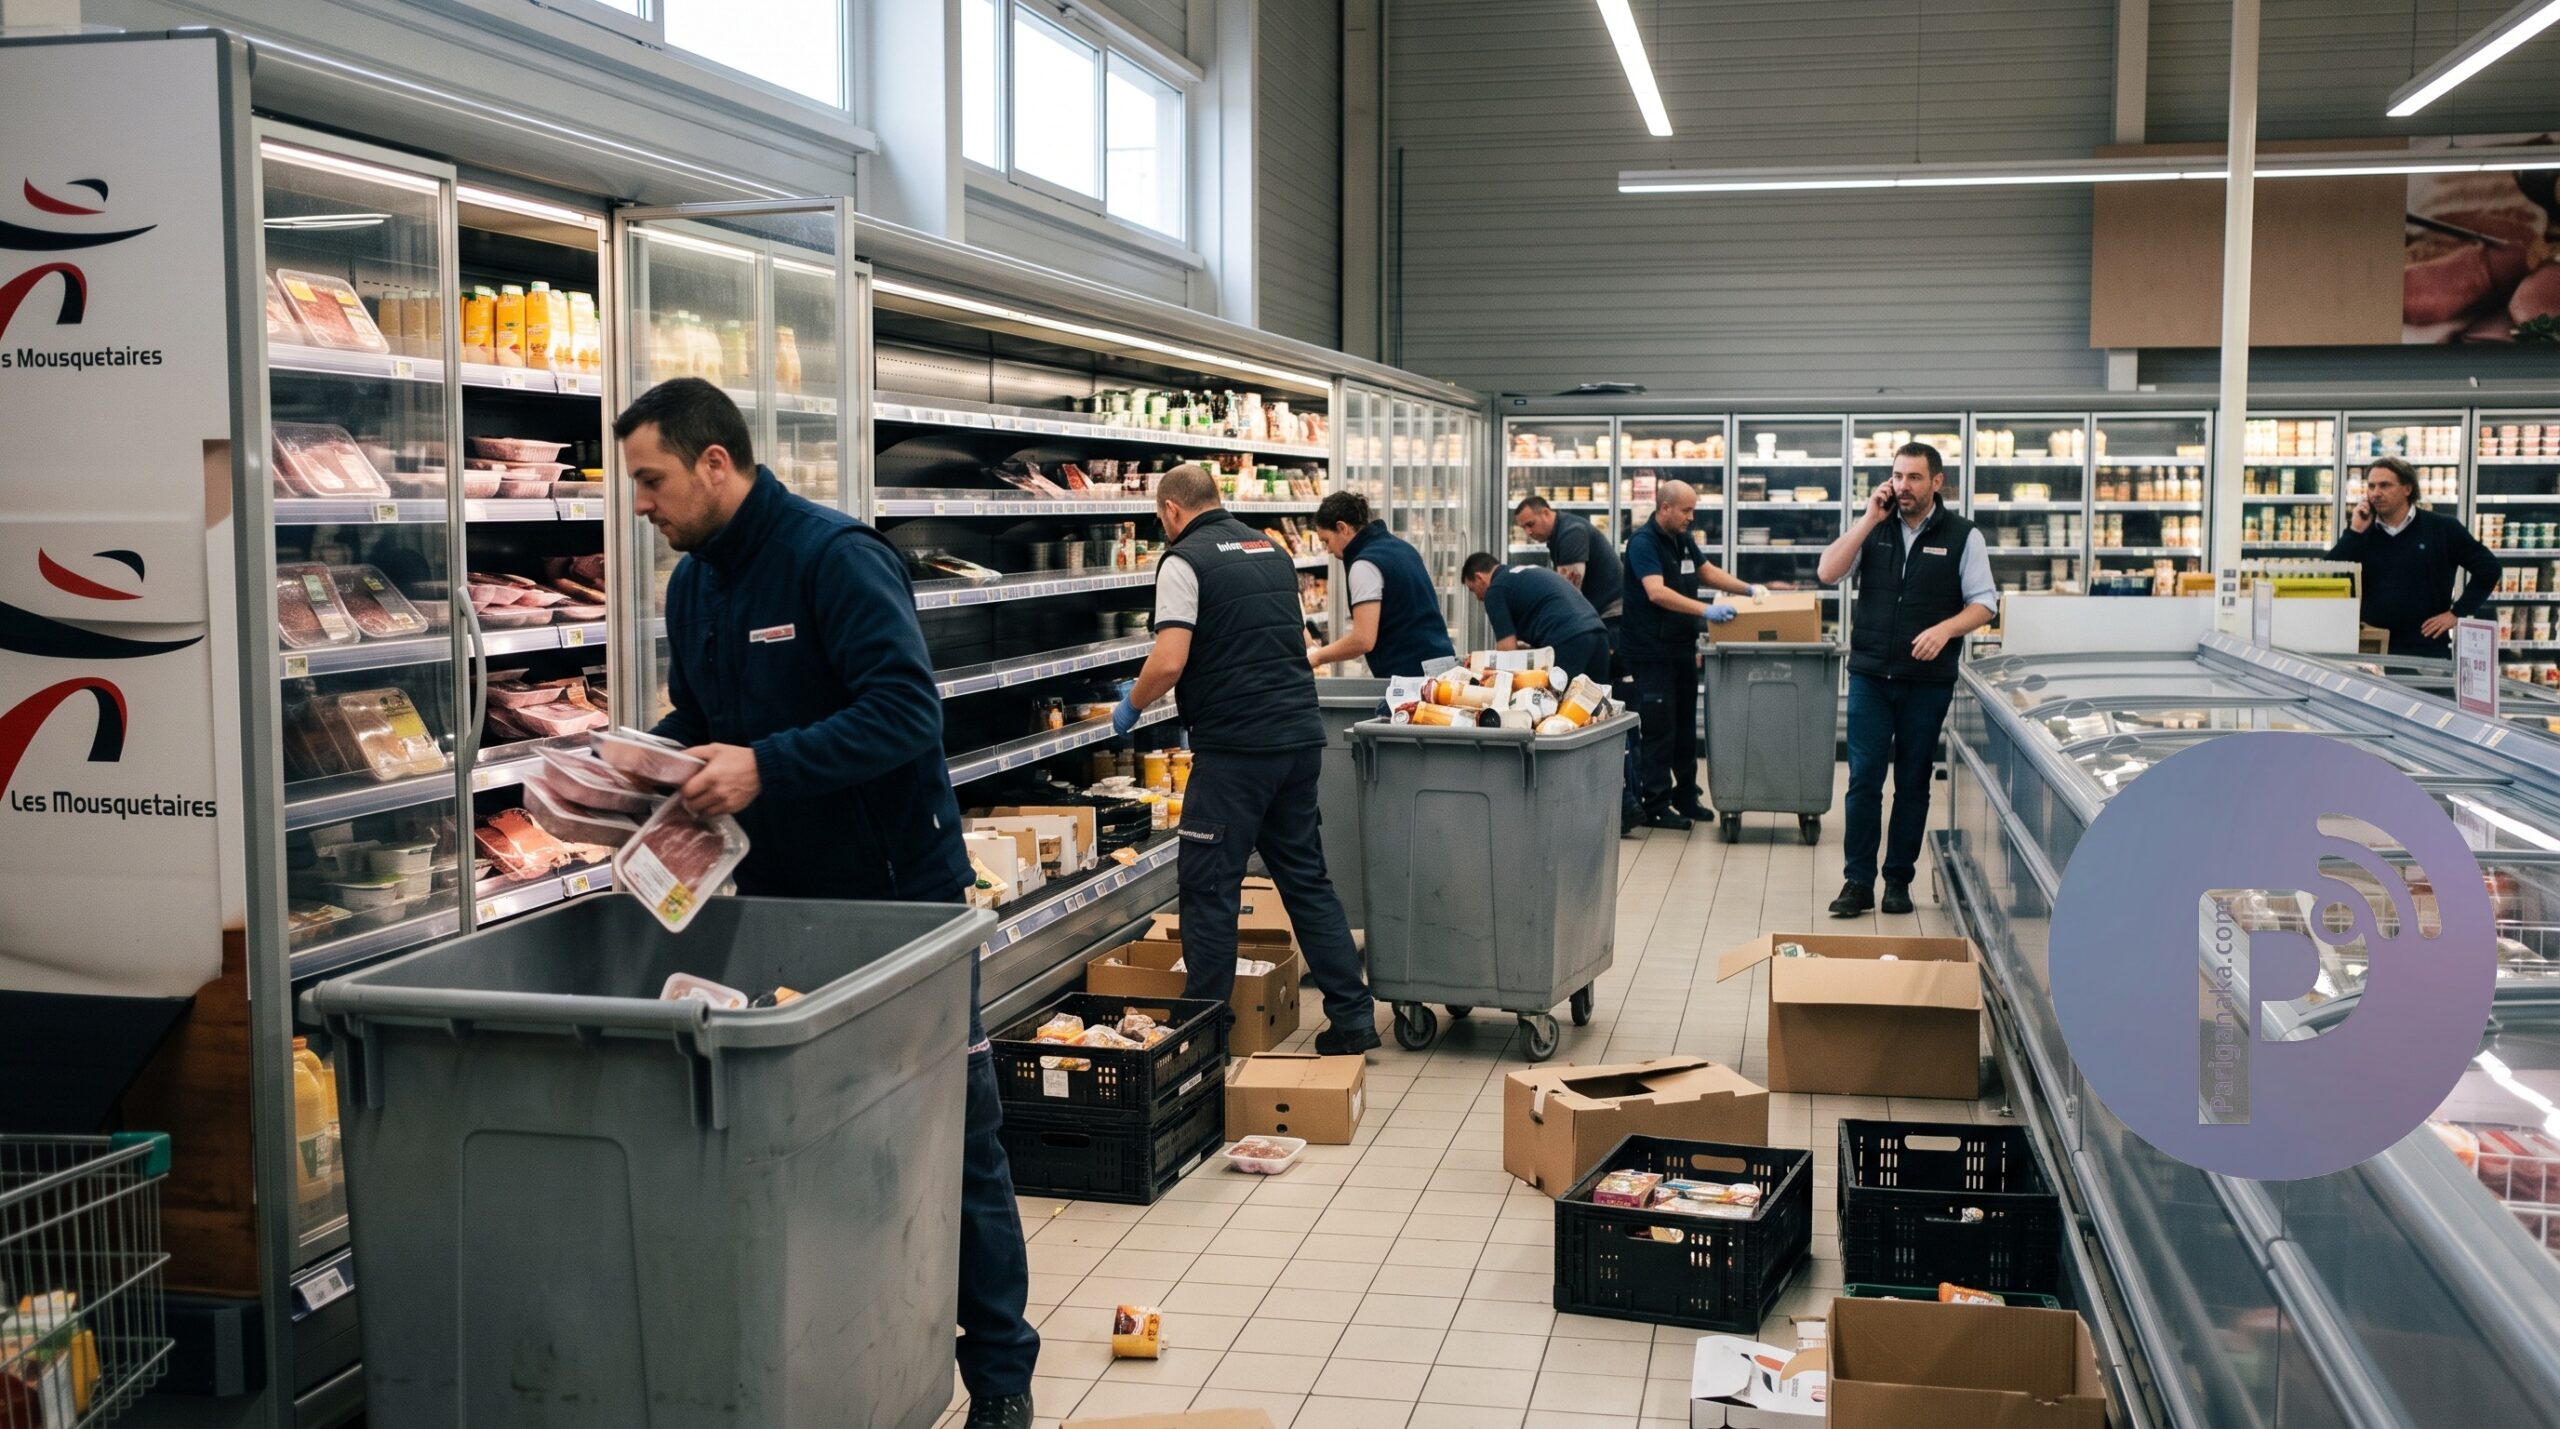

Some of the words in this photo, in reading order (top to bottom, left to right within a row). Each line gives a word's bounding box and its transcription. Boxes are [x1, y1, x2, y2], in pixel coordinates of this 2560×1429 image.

[17, 346, 162, 371] Mousquetaires
[11, 790, 47, 812] Les
[53, 791, 217, 820] Mousquetaires
